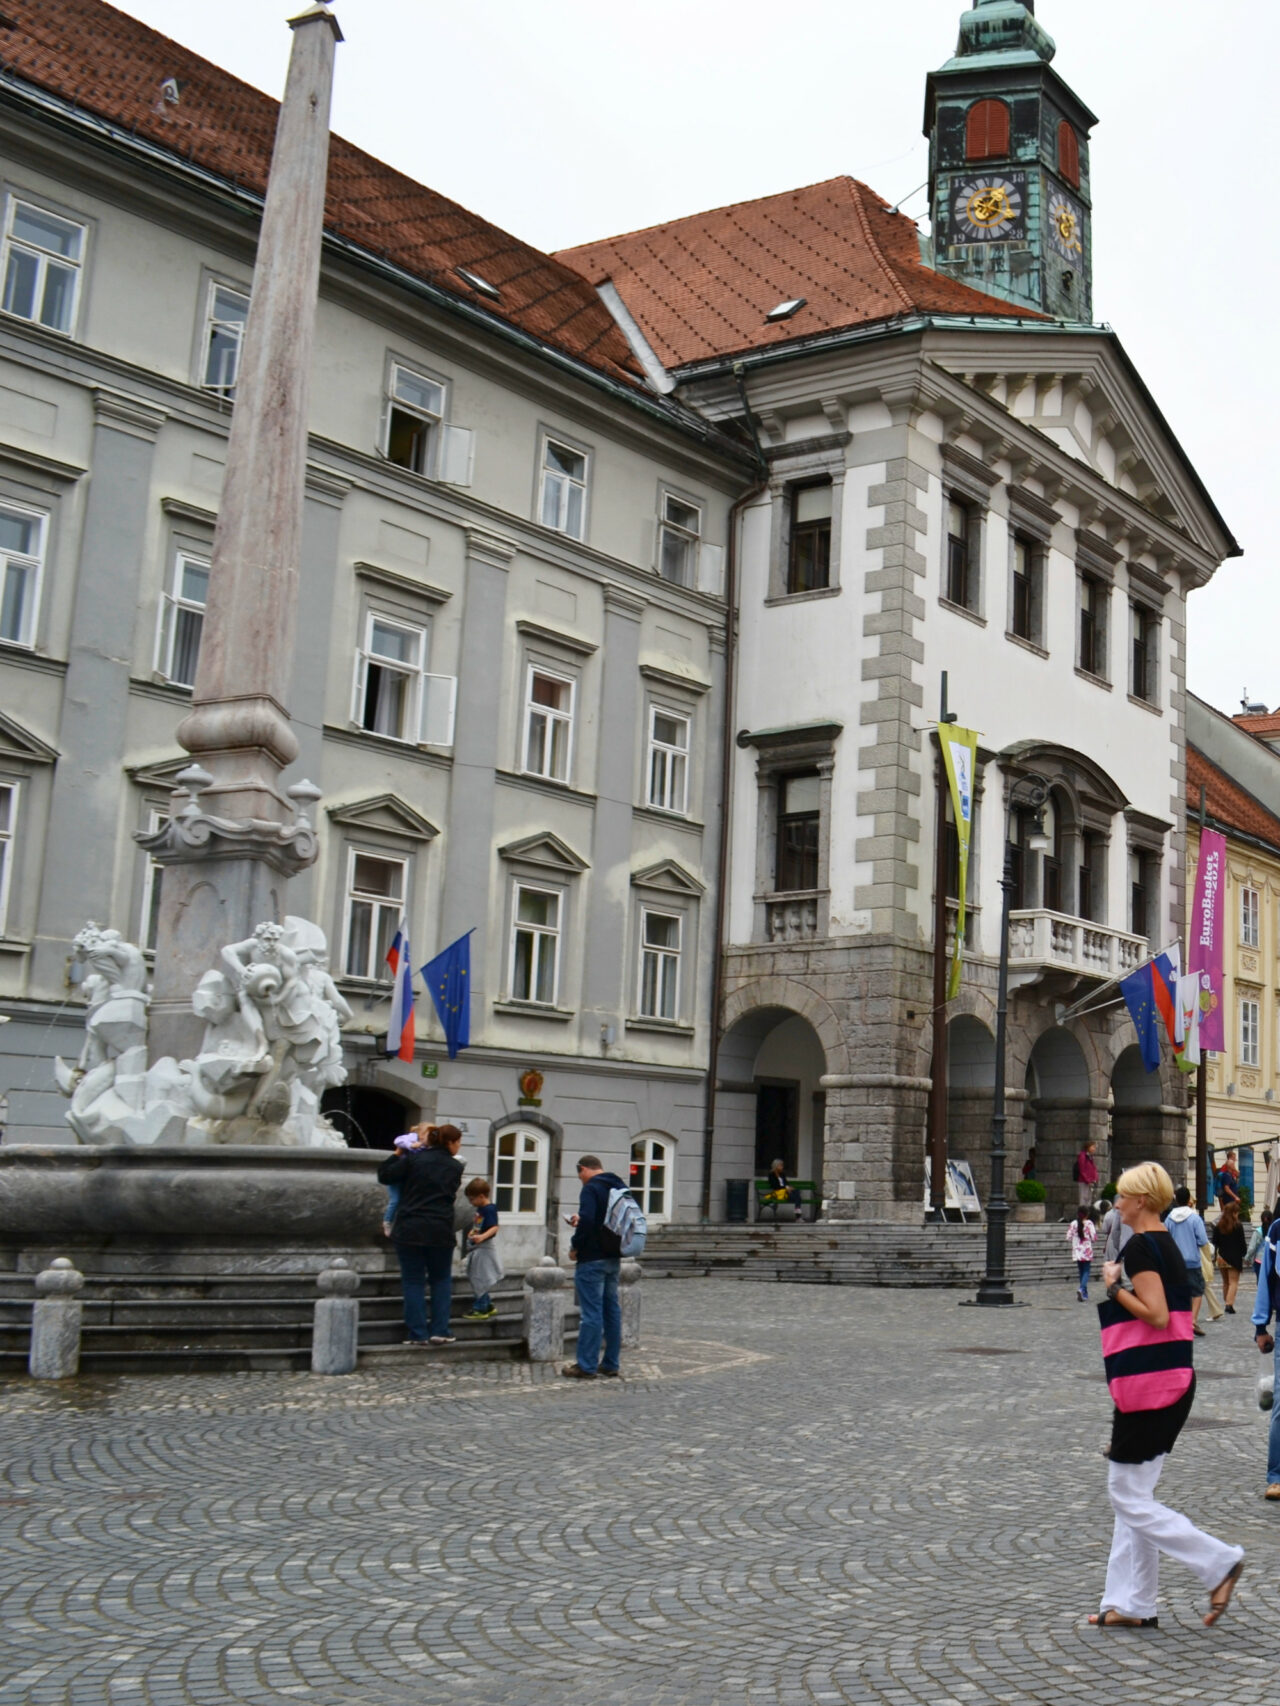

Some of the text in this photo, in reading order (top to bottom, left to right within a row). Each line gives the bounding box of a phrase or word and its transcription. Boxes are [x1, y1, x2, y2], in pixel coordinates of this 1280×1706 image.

[1012, 173, 1024, 183] 18
[952, 233, 965, 244] 19
[1200, 854, 1213, 945] EuroBasket
